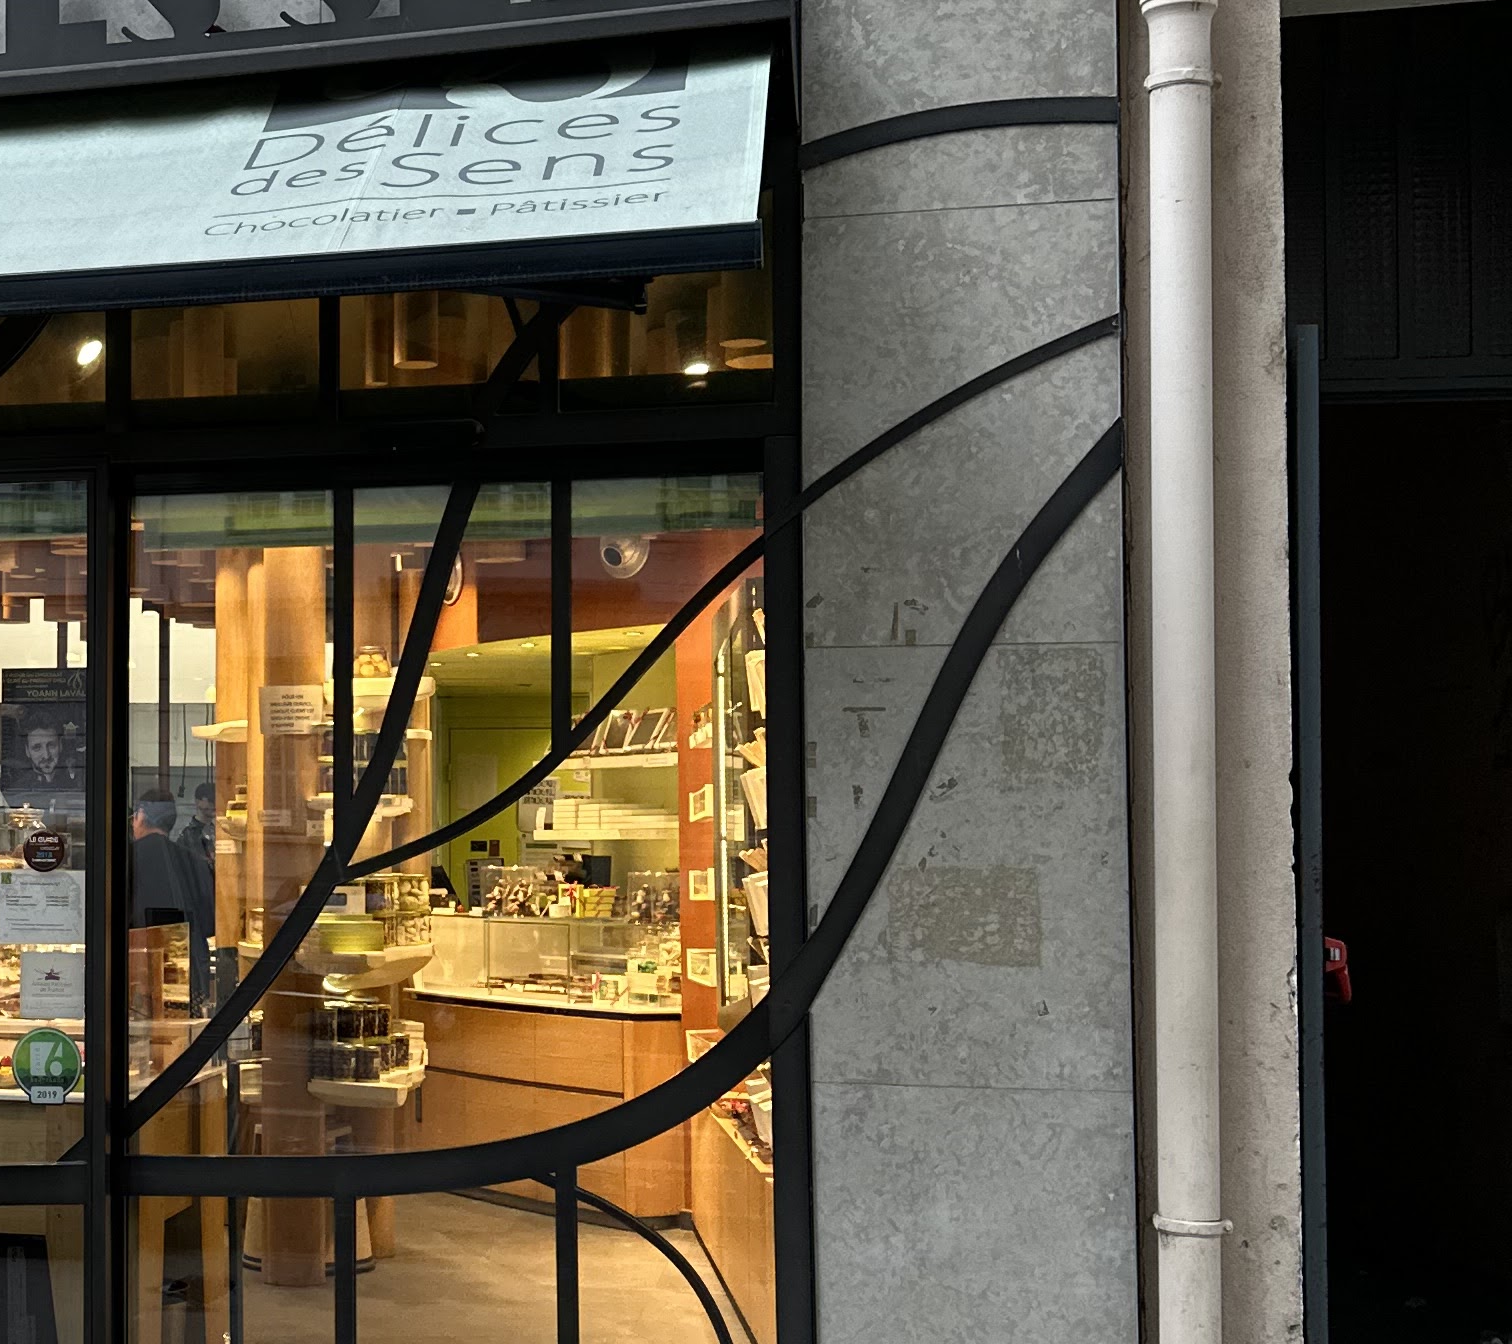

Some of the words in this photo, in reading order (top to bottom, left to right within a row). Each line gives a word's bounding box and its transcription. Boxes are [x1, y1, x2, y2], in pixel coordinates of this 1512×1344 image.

[243, 105, 681, 171] Délices
[230, 161, 365, 197] des
[379, 144, 675, 188] Sens
[204, 205, 445, 237] Chocolatier
[489, 189, 667, 217] Pâtissier
[36, 1090, 58, 1099] 2019
